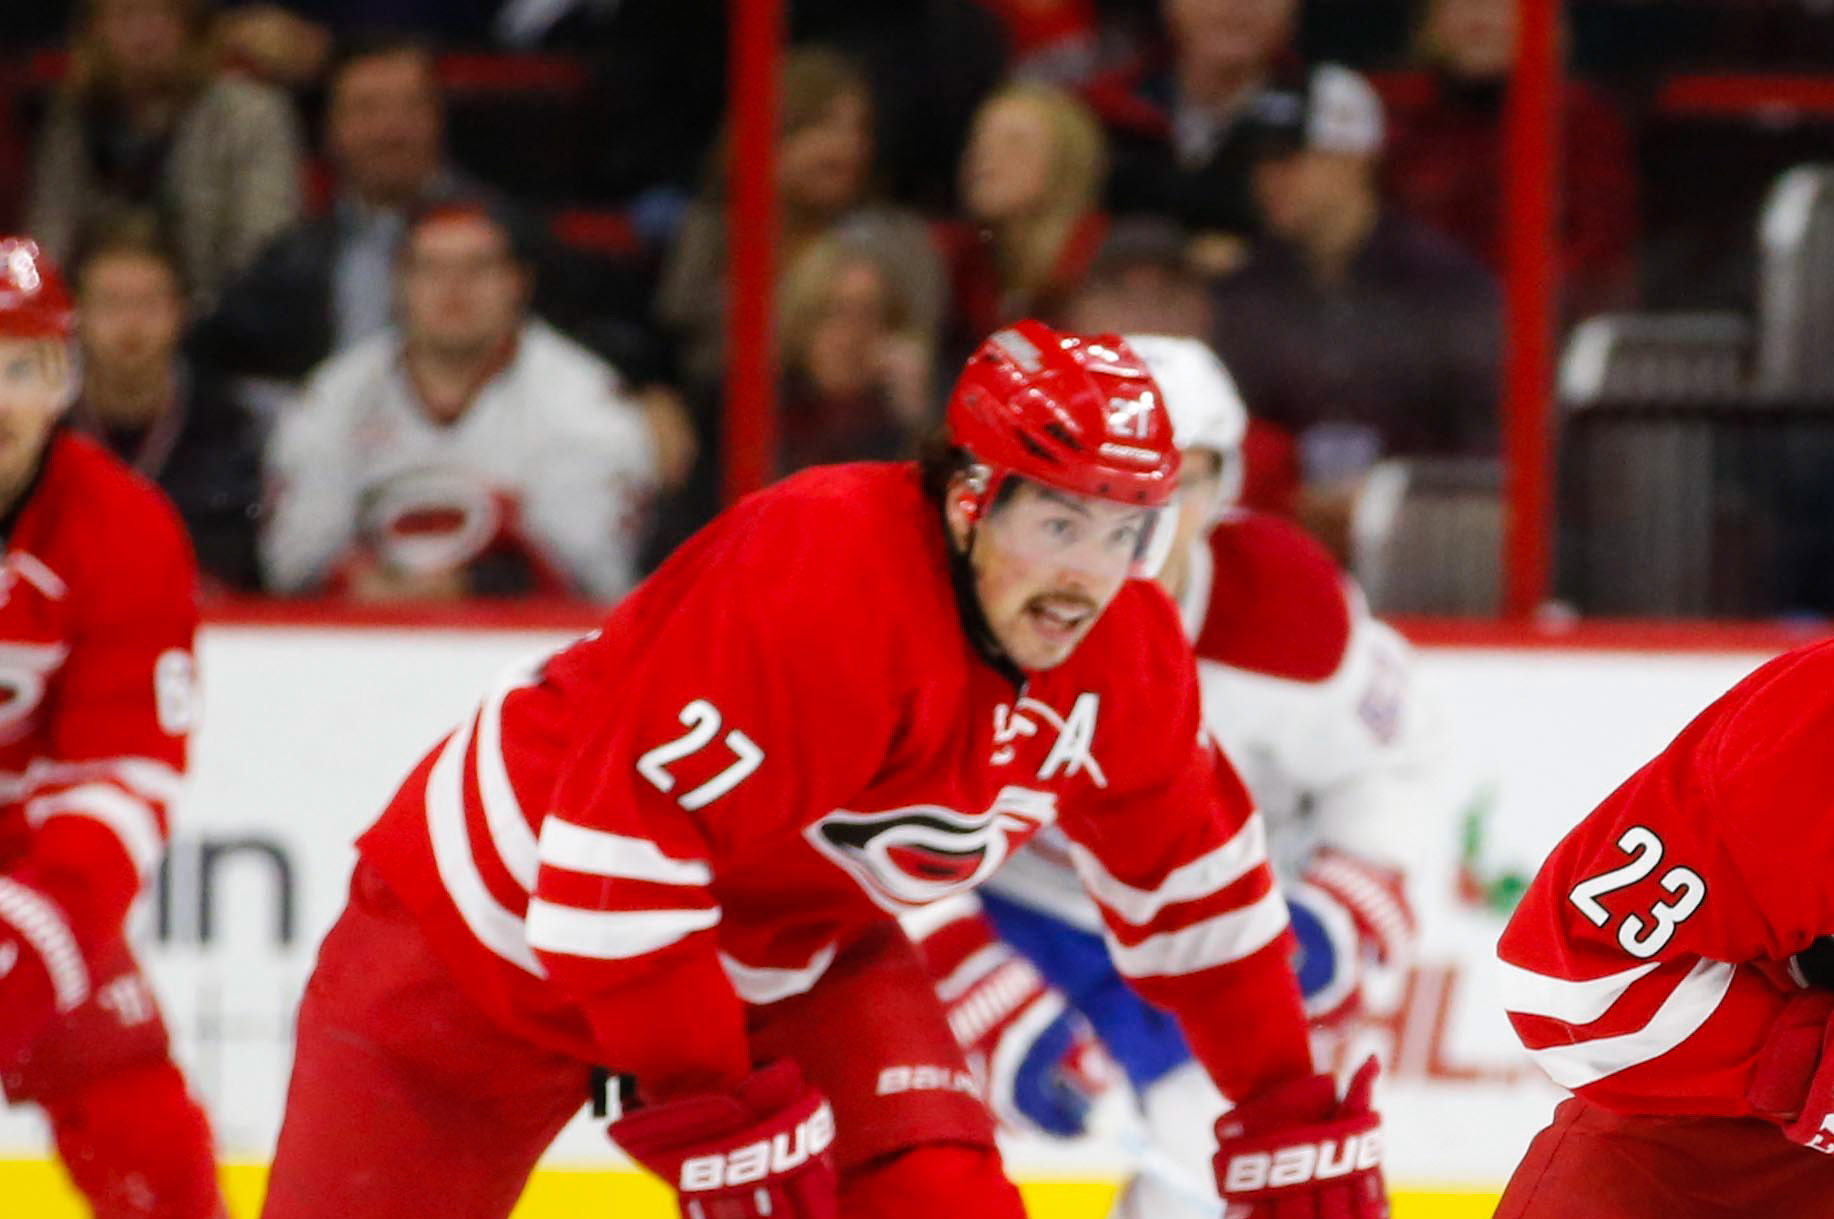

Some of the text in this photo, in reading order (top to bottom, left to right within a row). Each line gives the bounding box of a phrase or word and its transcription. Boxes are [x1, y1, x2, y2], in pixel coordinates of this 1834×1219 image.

[637, 699, 765, 811] 27
[1037, 691, 1107, 788] A
[1568, 825, 1706, 959] 23
